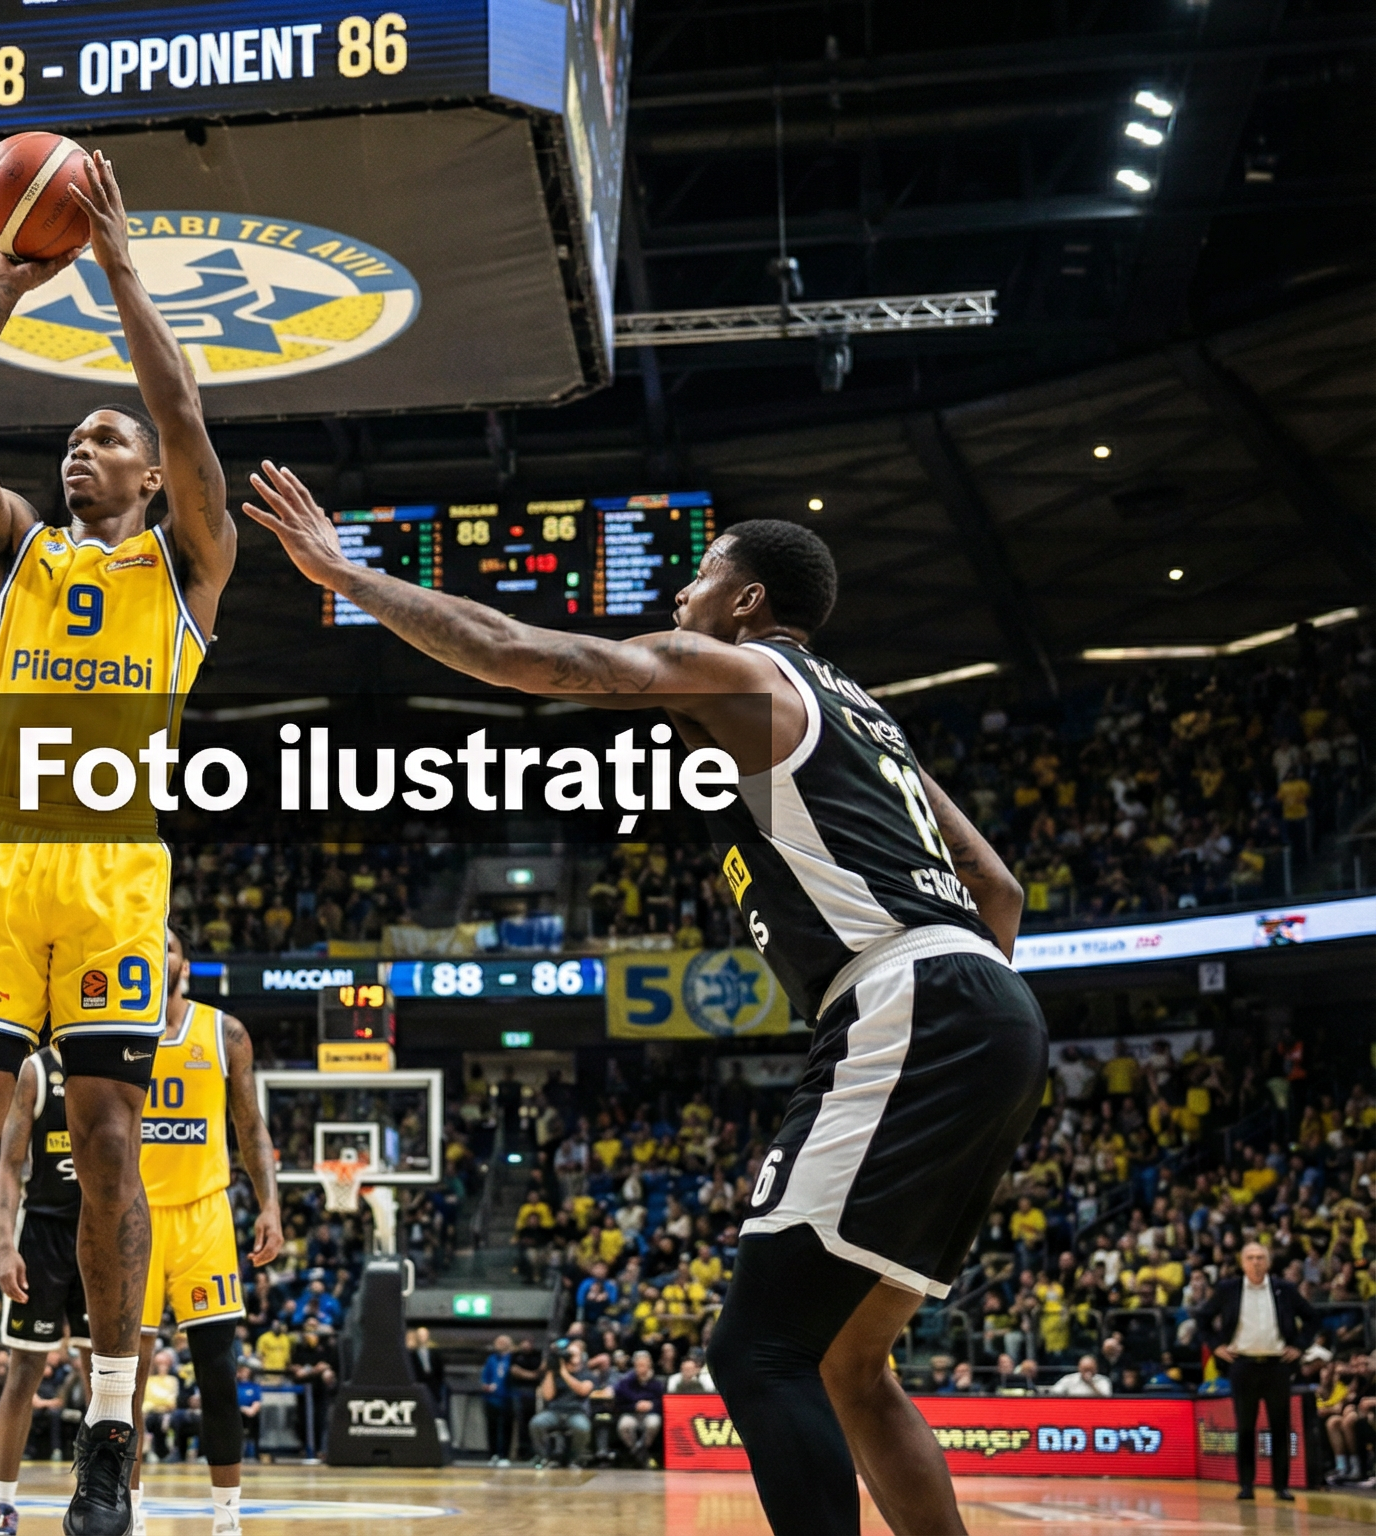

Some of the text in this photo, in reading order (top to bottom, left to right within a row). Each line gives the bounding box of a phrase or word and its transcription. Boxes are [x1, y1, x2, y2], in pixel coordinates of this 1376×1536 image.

[79, 23, 322, 96] OPPONENT
[338, 12, 408, 78] 86
[237, 219, 302, 249] TEL
[307, 240, 393, 277] AVIV
[67, 584, 104, 636] 9
[118, 956, 151, 1010] 9
[432, 962, 483, 996] 88
[532, 961, 583, 995] 86
[150, 1076, 184, 1109] 10
